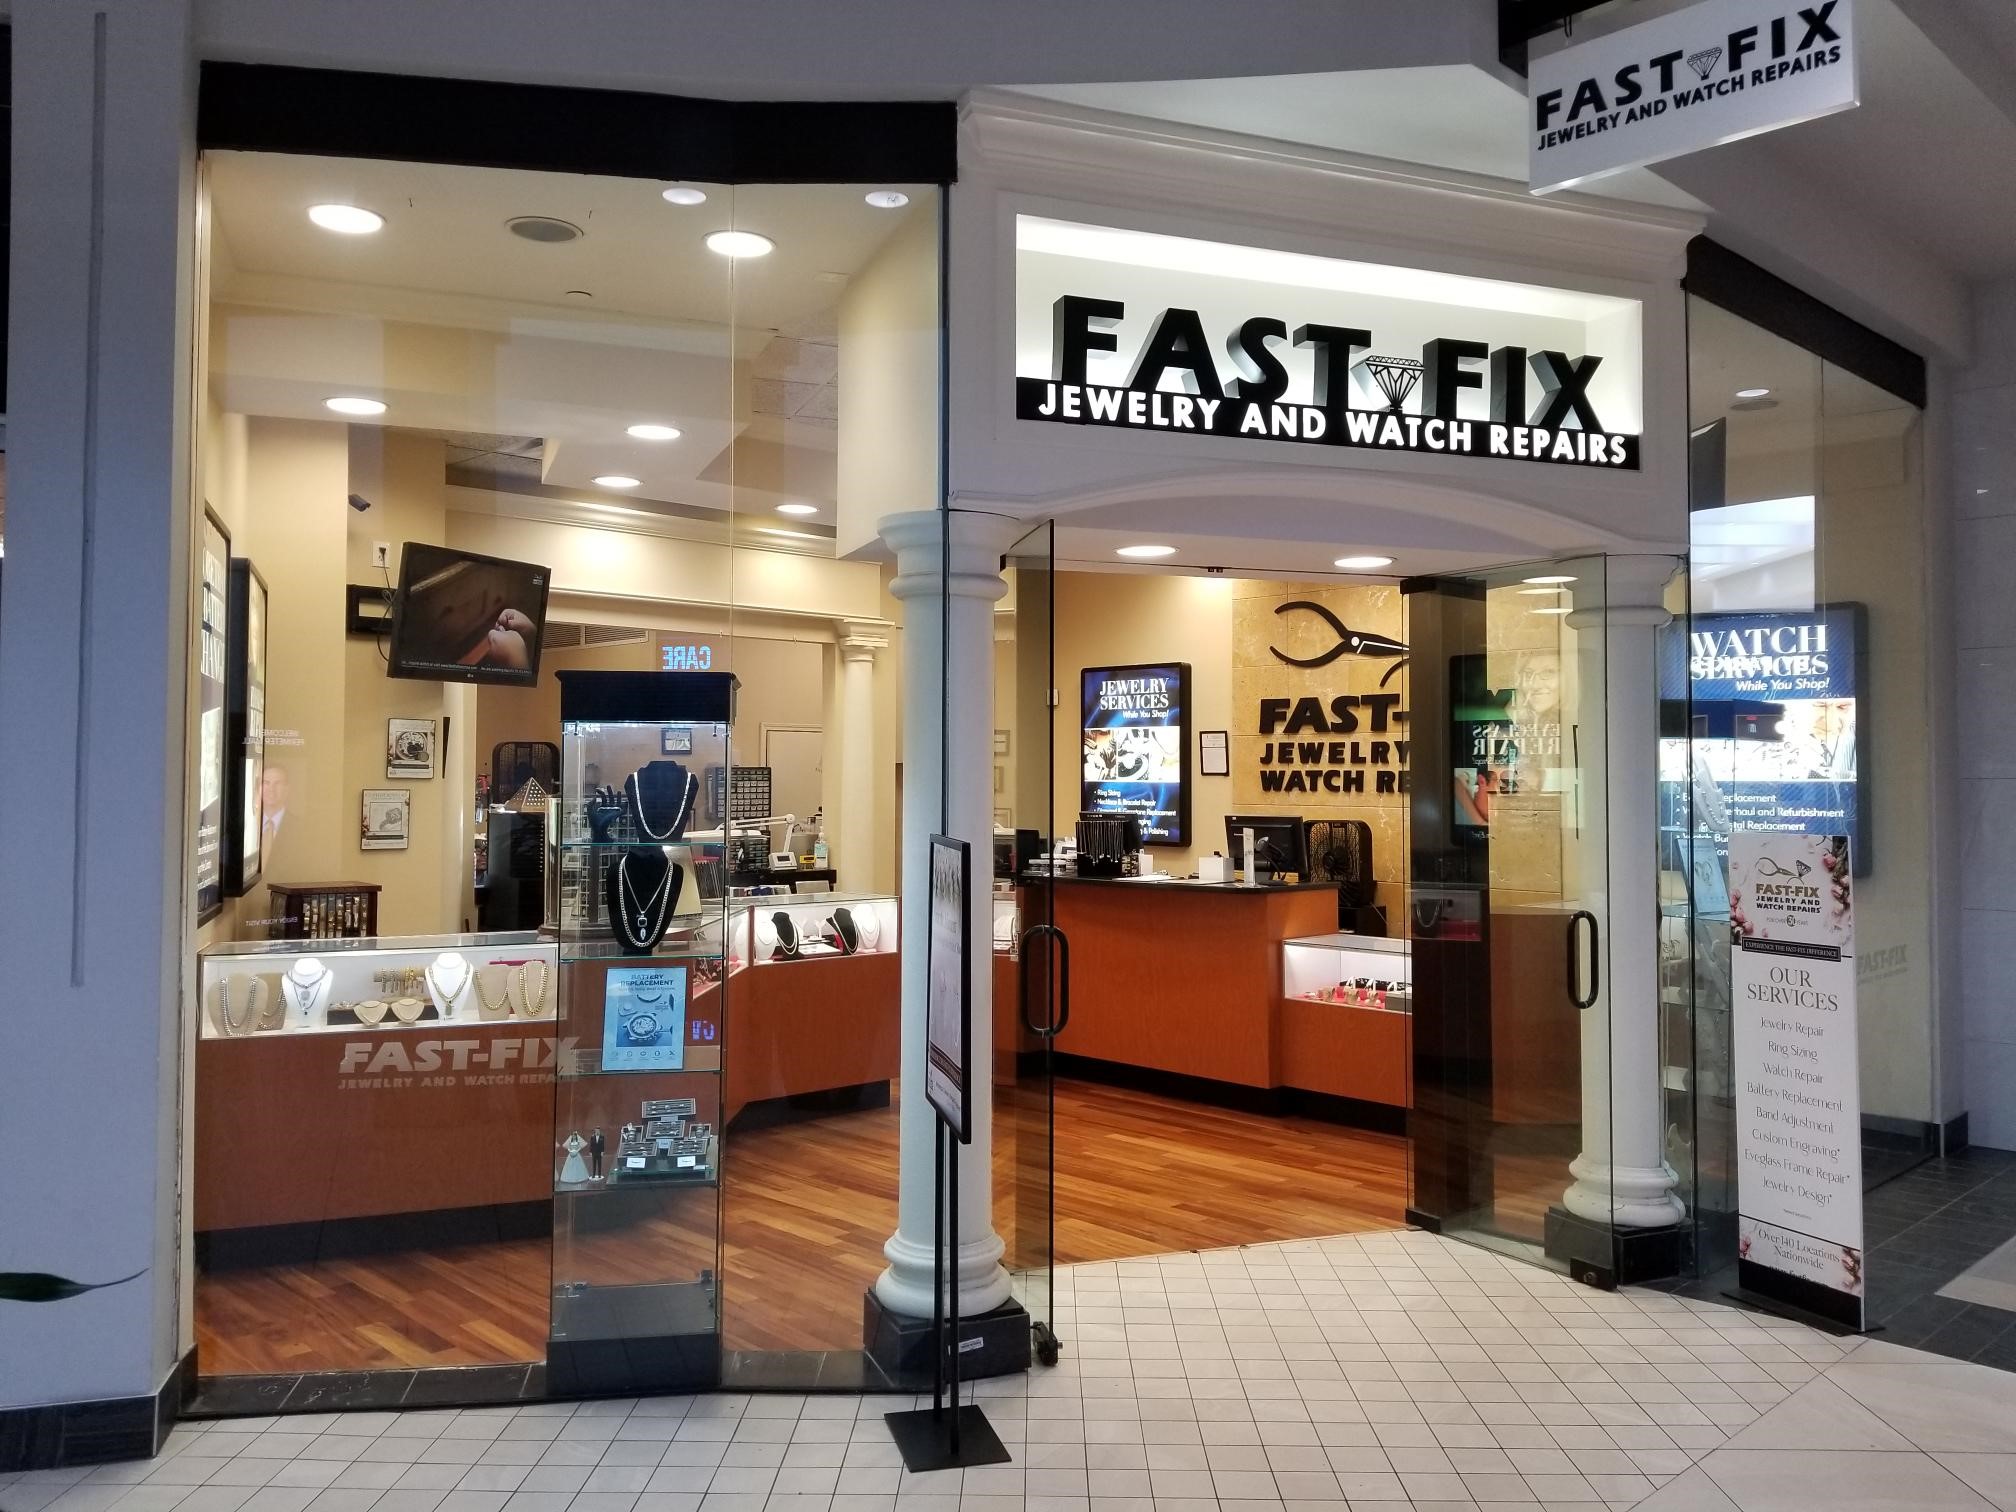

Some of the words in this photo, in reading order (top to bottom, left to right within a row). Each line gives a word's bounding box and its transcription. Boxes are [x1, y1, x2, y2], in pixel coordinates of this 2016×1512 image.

[1536, 49, 1683, 131] FAST
[1728, 0, 1841, 72] FIX
[1537, 112, 1621, 151] JEWELRY
[1625, 97, 1667, 125] AND
[1673, 74, 1745, 109] WATCH
[1751, 45, 1841, 87] REPAIRS
[1053, 294, 1372, 407] FAST
[1422, 337, 1604, 431] FIX
[1038, 383, 1222, 430] JEWELRY
[1240, 403, 1328, 440] AND
[1345, 413, 1473, 452] WATCH
[1488, 425, 1628, 466] REPAIRS
[1691, 624, 1829, 657] WATCH
[1100, 678, 1169, 696] JEWELRY
[1736, 680, 1768, 691] While
[1771, 680, 1792, 690] You
[1795, 677, 1830, 691] Shop!
[1100, 694, 1169, 710] SERVICES
[1122, 710, 1139, 719] While
[1140, 710, 1151, 718] You
[1152, 709, 1169, 719] Shop!
[1259, 693, 1410, 735] FAST-
[1259, 741, 1411, 764] JEWELRY
[1259, 769, 1365, 793] WATCH
[1723, 794, 1777, 803] eplacement
[1758, 808, 1775, 816] and
[1778, 807, 1845, 818] Refurbishment
[1747, 820, 1806, 832] Replacement
[1756, 883, 1820, 898] FAST-FIX
[1756, 896, 1796, 904] JEWELRY
[1800, 898, 1820, 906] AND
[1756, 903, 1784, 911] WATCH
[1787, 905, 1821, 913] REPAIRS
[1770, 966, 1812, 988] OUR
[1747, 983, 1838, 1012] SERVICES
[1760, 1016, 1792, 1032] Jewelry
[1796, 1022, 1824, 1038] Repair
[338, 1036, 580, 1075] FAST-FIX
[1768, 1040, 1789, 1058] Ring
[1791, 1045, 1818, 1064] Sizing
[338, 1077, 412, 1090] JEWELRY
[421, 1076, 457, 1087] AND
[464, 1075, 515, 1086] WATCH
[1763, 1062, 1792, 1078] Watch
[1794, 1068, 1824, 1084] Repair
[1747, 1082, 1779, 1097] Battery
[1782, 1089, 1843, 1112] Replacement
[1756, 1107, 1779, 1121] Band
[1782, 1112, 1834, 1133] Adjustment
[1752, 1129, 1788, 1146] Custom
[1744, 1148, 1781, 1168] Eyeglass
[1784, 1159, 1814, 1176] Frame
[1763, 1176, 1794, 1193] Jewelry
[1758, 1229, 1779, 1242] Over
[1796, 1240, 1840, 1262] Locations
[1774, 1245, 1824, 1269] Nationwide
